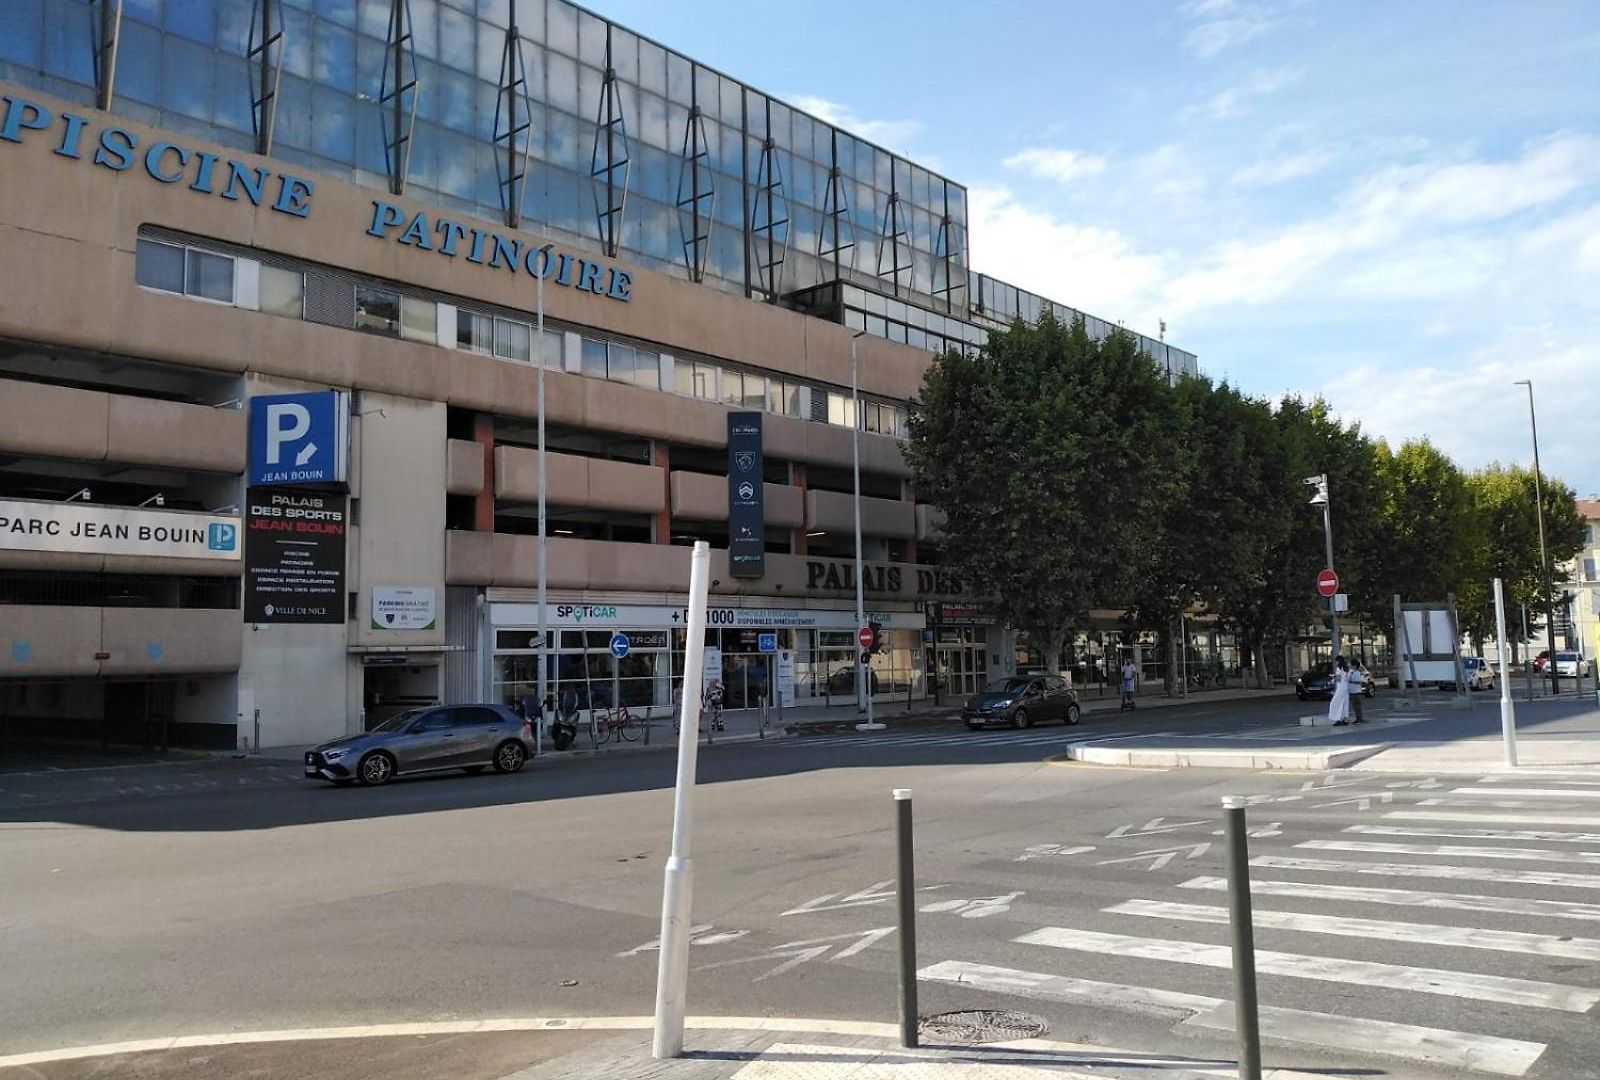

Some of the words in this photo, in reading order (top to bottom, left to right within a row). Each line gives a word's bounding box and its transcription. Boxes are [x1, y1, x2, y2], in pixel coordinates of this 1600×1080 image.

[0, 97, 315, 218] PISCINE
[366, 201, 633, 302] PATINOIRE
[266, 403, 311, 464] P
[261, 471, 288, 482] JEAN
[291, 470, 323, 480] BOUIN
[272, 495, 323, 508] PALAIS
[251, 505, 281, 516] DES
[286, 508, 342, 521] SPORTS
[70, 521, 129, 540] JEAN
[139, 526, 204, 543] BOUIN
[250, 519, 292, 531] JEAN
[296, 521, 344, 534] BOUIN
[806, 561, 900, 592] PALAIS
[916, 568, 964, 595] DES
[296, 607, 307, 615] DE
[308, 607, 327, 615] NICE
[706, 610, 735, 624] 1000
